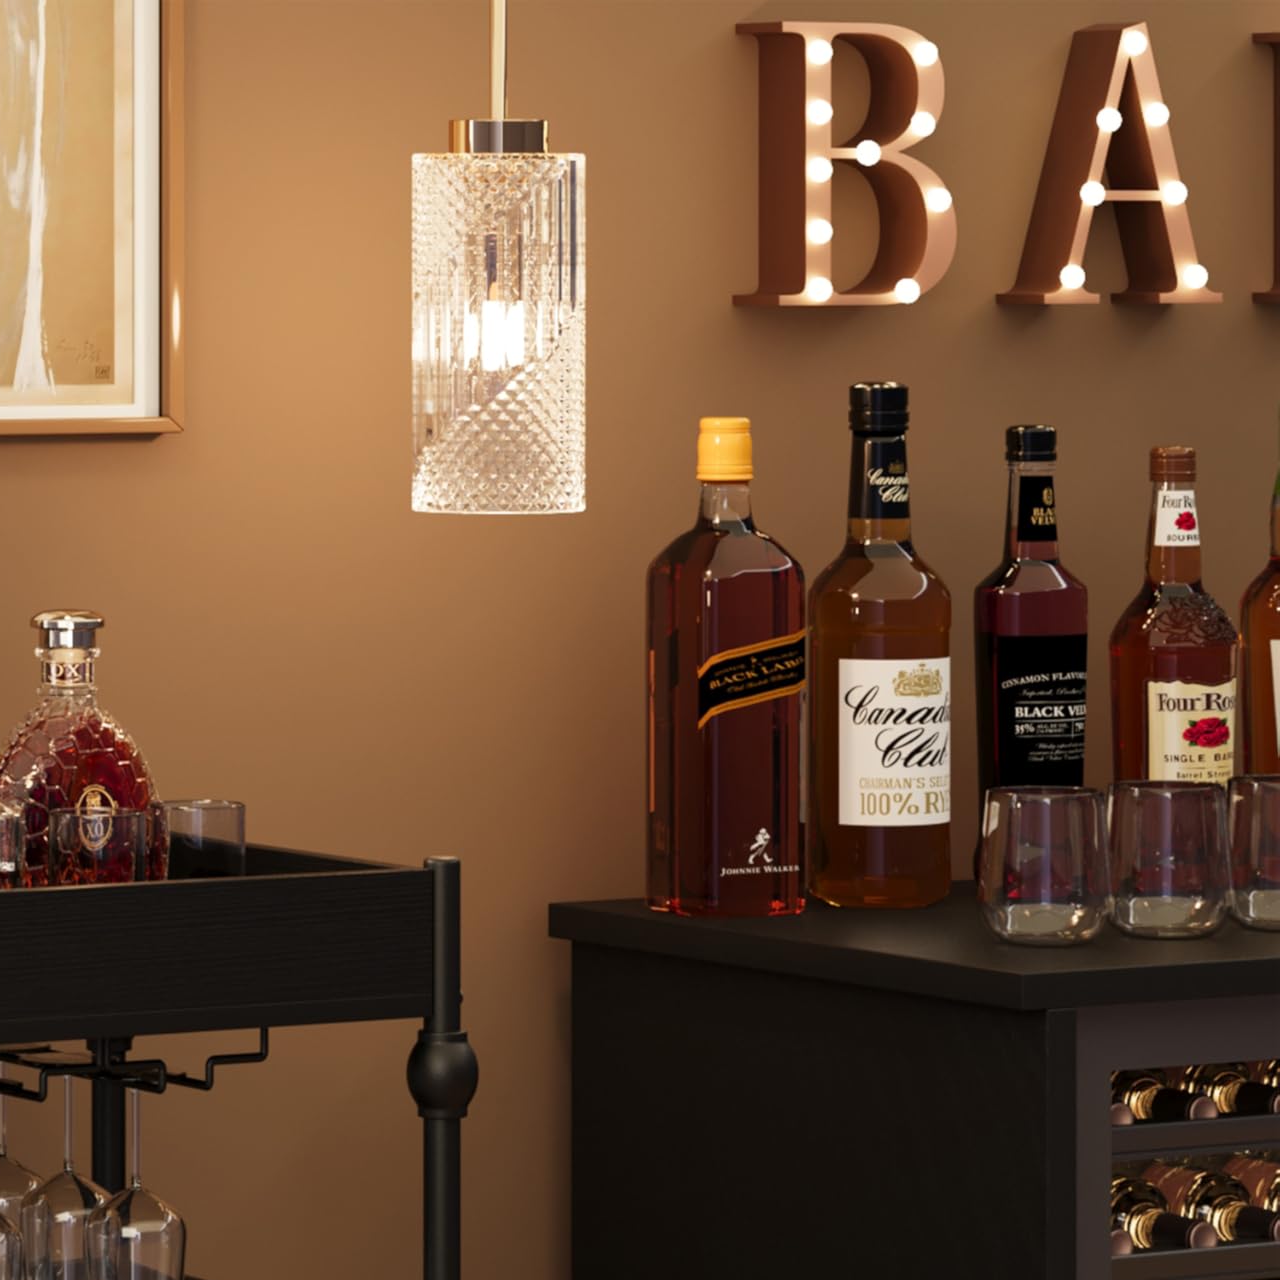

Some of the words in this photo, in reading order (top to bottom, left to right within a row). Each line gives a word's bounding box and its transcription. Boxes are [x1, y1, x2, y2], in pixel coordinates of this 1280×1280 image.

[732, 20, 1280, 306] BA
[709, 671, 759, 690] BLACK
[1001, 673, 1050, 689] CINNAMON
[1157, 692, 1201, 712] Four
[1014, 705, 1065, 718] BLACK
[1163, 754, 1205, 763] SINGLE
[859, 776, 925, 789] CHAIRMAN'S
[860, 792, 920, 816] 100%
[720, 867, 761, 877] JOHNNIE
[763, 864, 800, 873] WALKER
